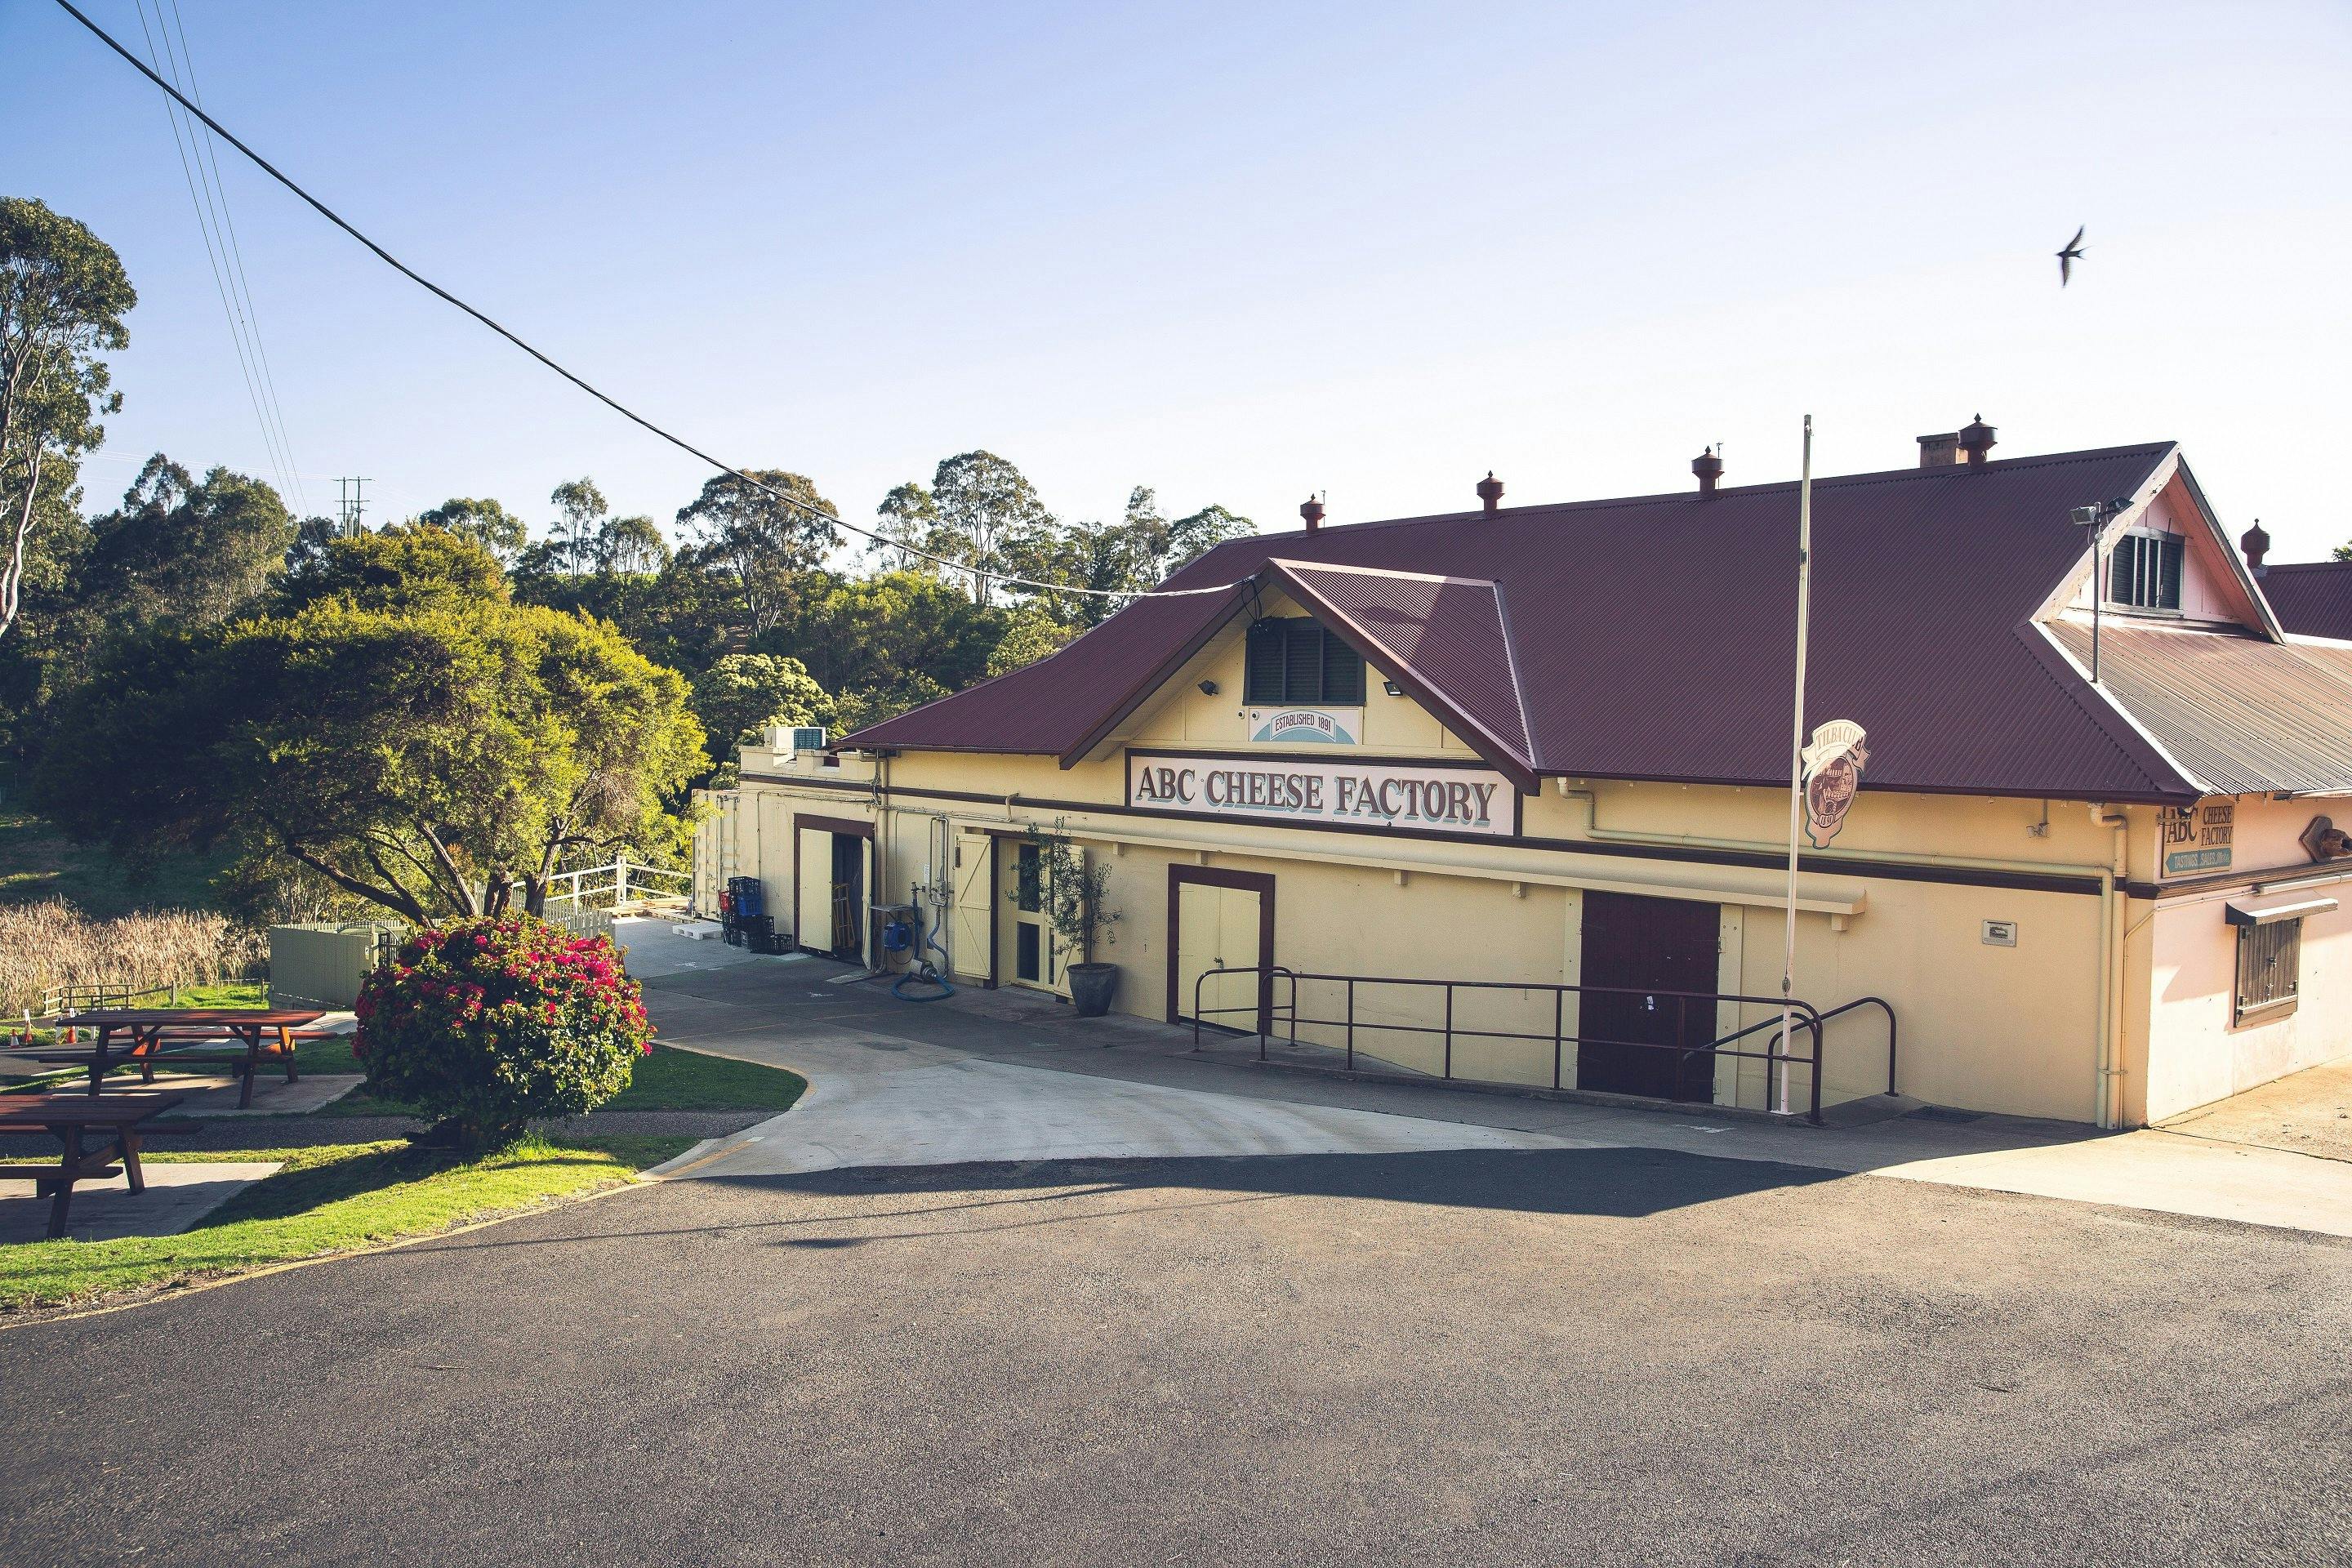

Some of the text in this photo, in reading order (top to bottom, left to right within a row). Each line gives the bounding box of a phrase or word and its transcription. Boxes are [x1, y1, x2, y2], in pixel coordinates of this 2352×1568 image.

[1275, 713, 1331, 733] ESTABLISHED 1891
[1135, 765, 1498, 827] ABC CHEESE FACTORY
[2203, 805, 2233, 825] CHEESE
[2200, 826, 2234, 846] FACTORY
